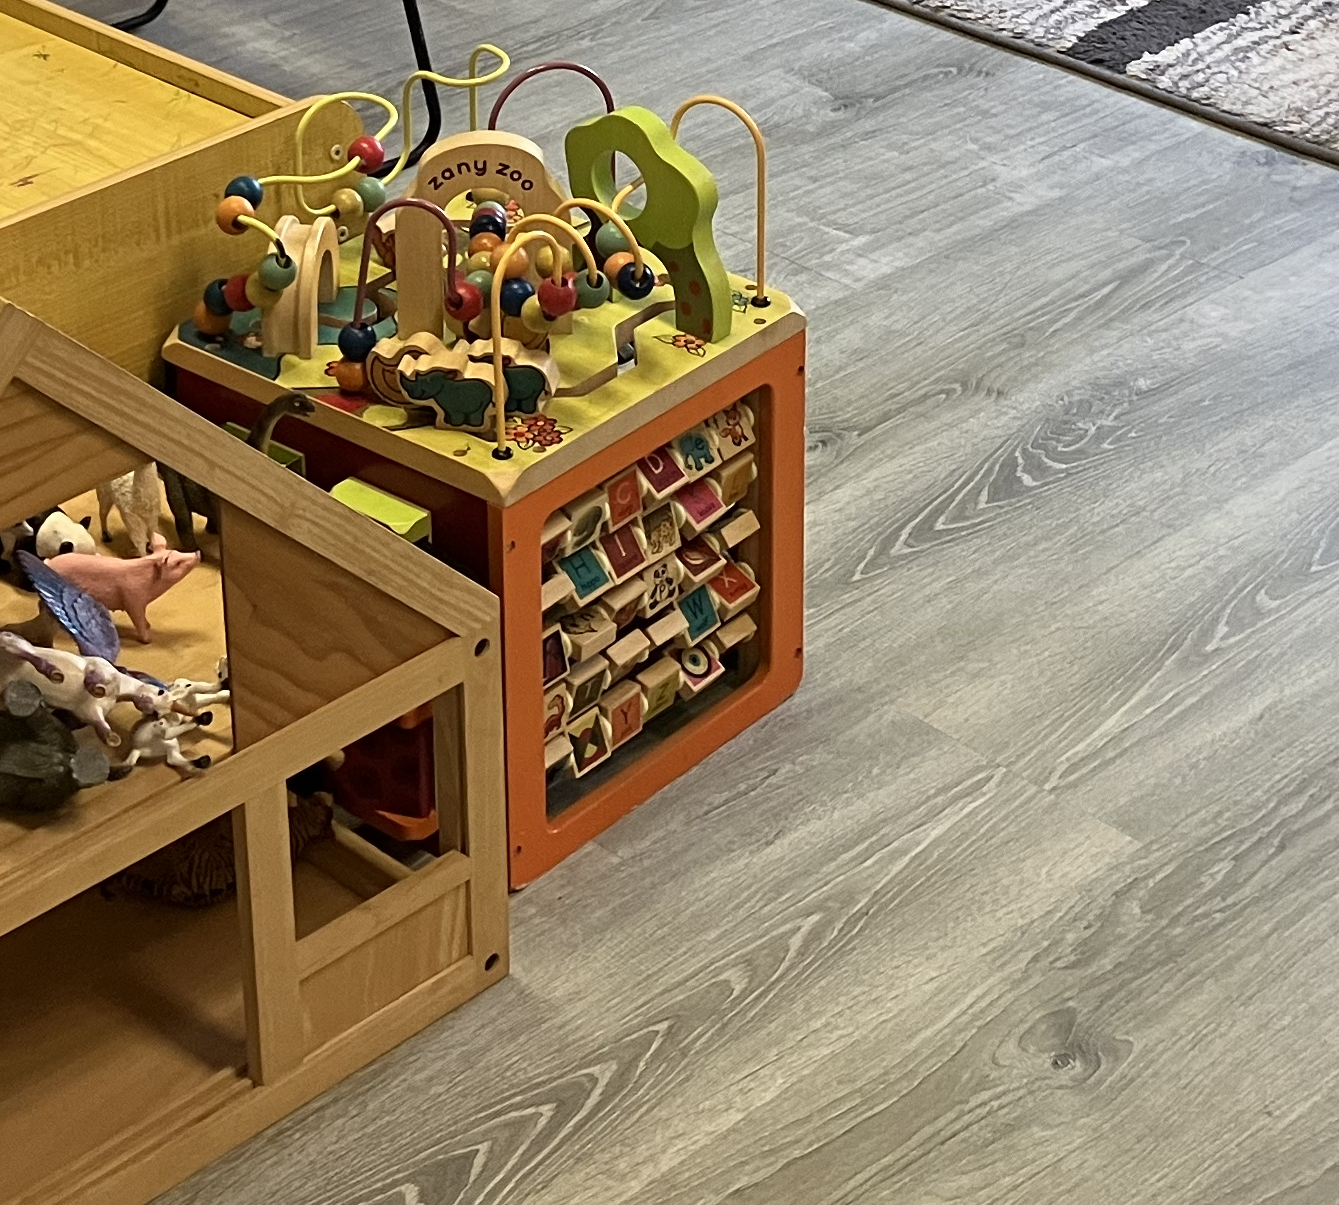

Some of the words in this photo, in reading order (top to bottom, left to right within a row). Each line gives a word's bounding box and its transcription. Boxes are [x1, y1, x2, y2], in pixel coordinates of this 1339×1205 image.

[427, 160, 487, 191] zany
[495, 162, 534, 191] zoo
[644, 453, 664, 474] D
[568, 554, 592, 579] H
[718, 570, 737, 589] X
[685, 598, 704, 621] W
[620, 697, 633, 724] Y
